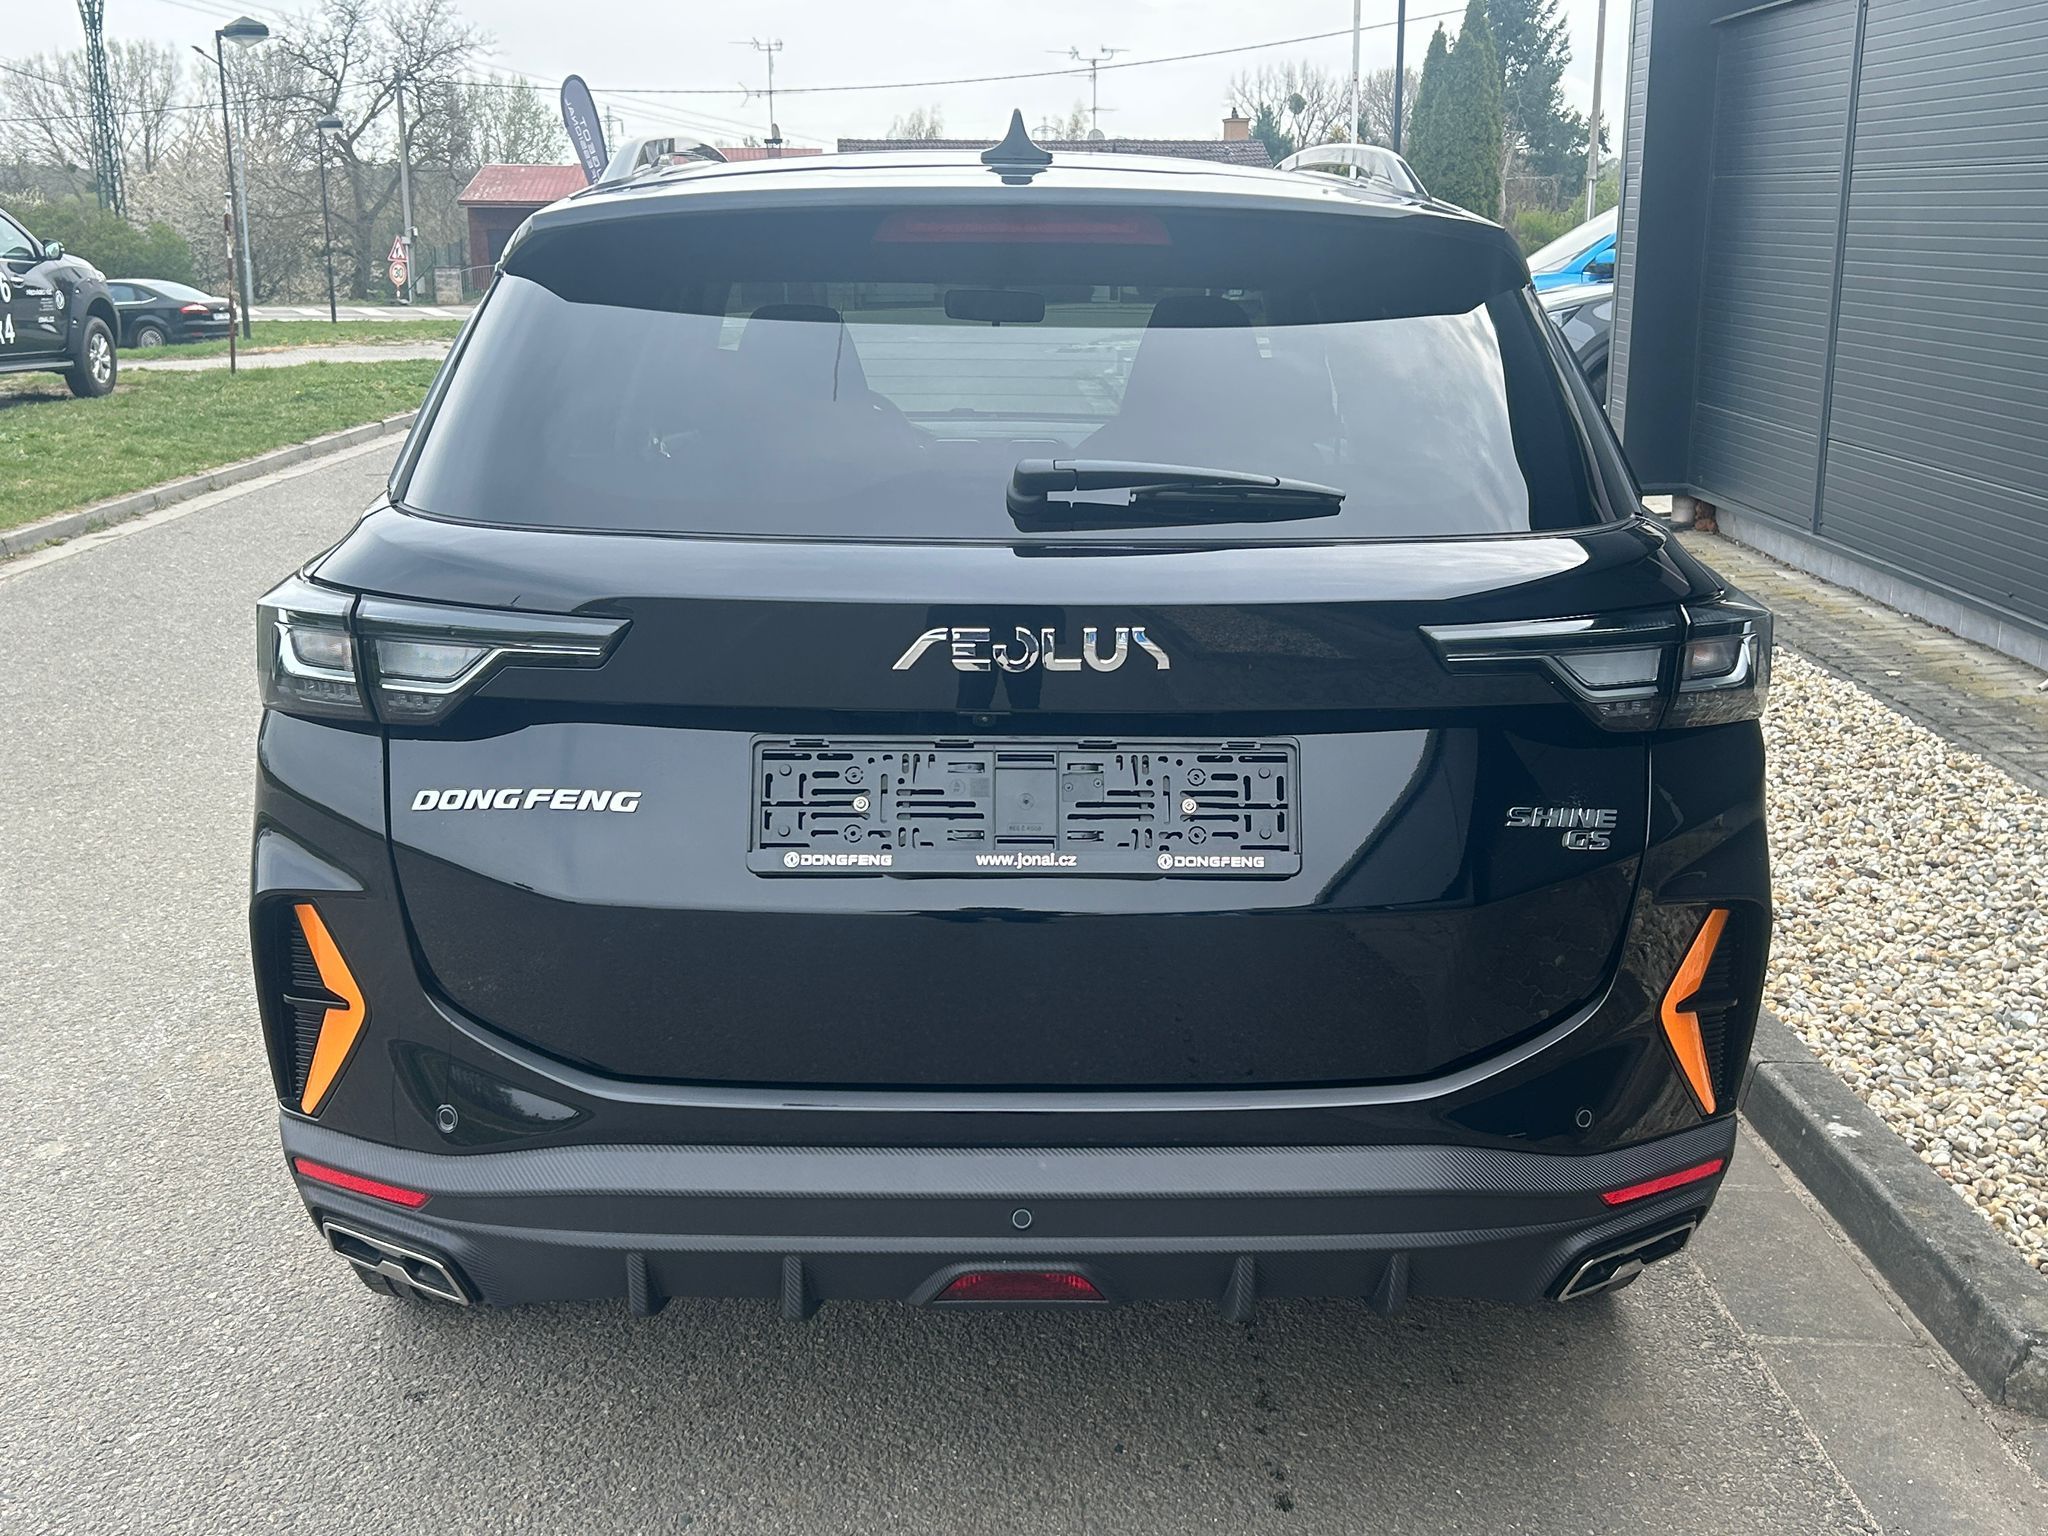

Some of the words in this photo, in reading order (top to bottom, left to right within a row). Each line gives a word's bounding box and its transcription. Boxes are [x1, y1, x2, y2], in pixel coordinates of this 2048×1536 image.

[411, 788, 642, 813] DONGFENG
[1504, 806, 1618, 829] SHINE
[1562, 829, 1612, 850] GS
[800, 853, 893, 867] DONGFENG
[1173, 855, 1265, 868] DONGFENG
